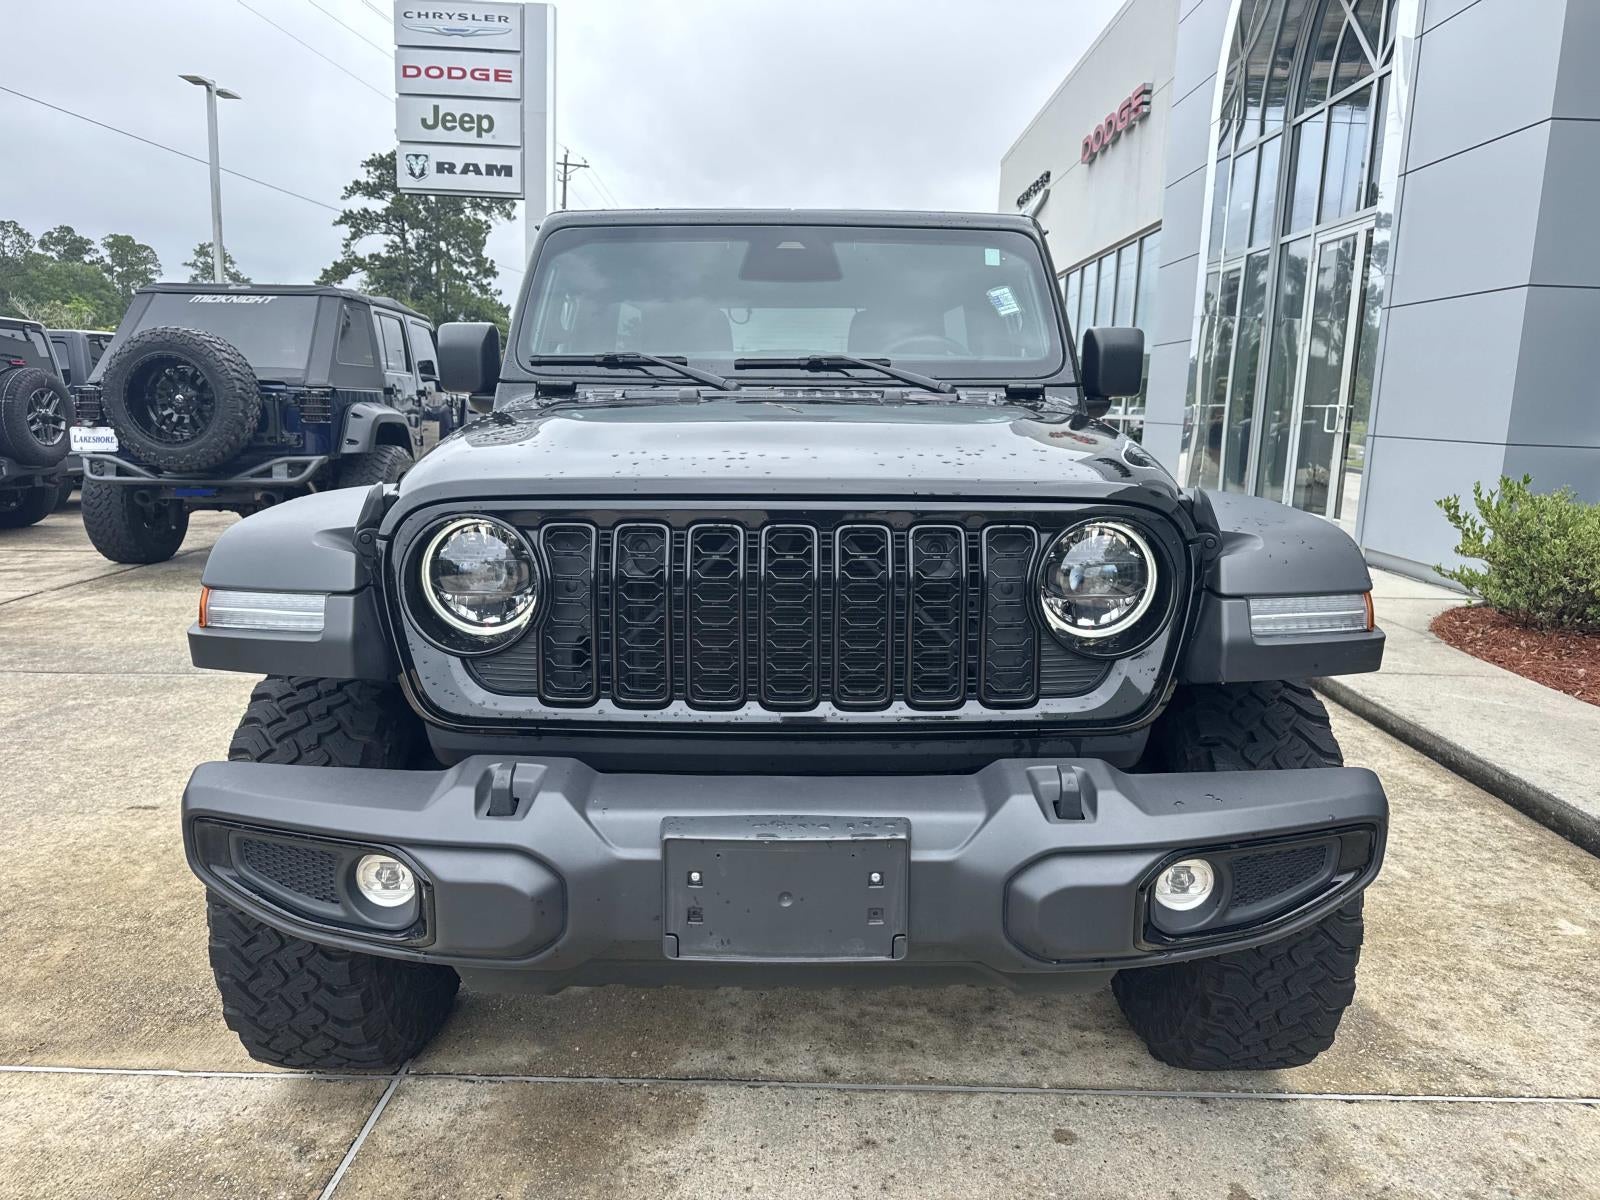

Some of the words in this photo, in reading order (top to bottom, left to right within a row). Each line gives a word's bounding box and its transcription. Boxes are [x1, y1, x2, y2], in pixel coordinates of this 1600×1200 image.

[403, 11, 510, 23] CHRYSLER
[402, 65, 512, 83] DODGE
[421, 104, 494, 138] Jeep
[1081, 83, 1153, 164] DODGE
[436, 161, 513, 178] RAM
